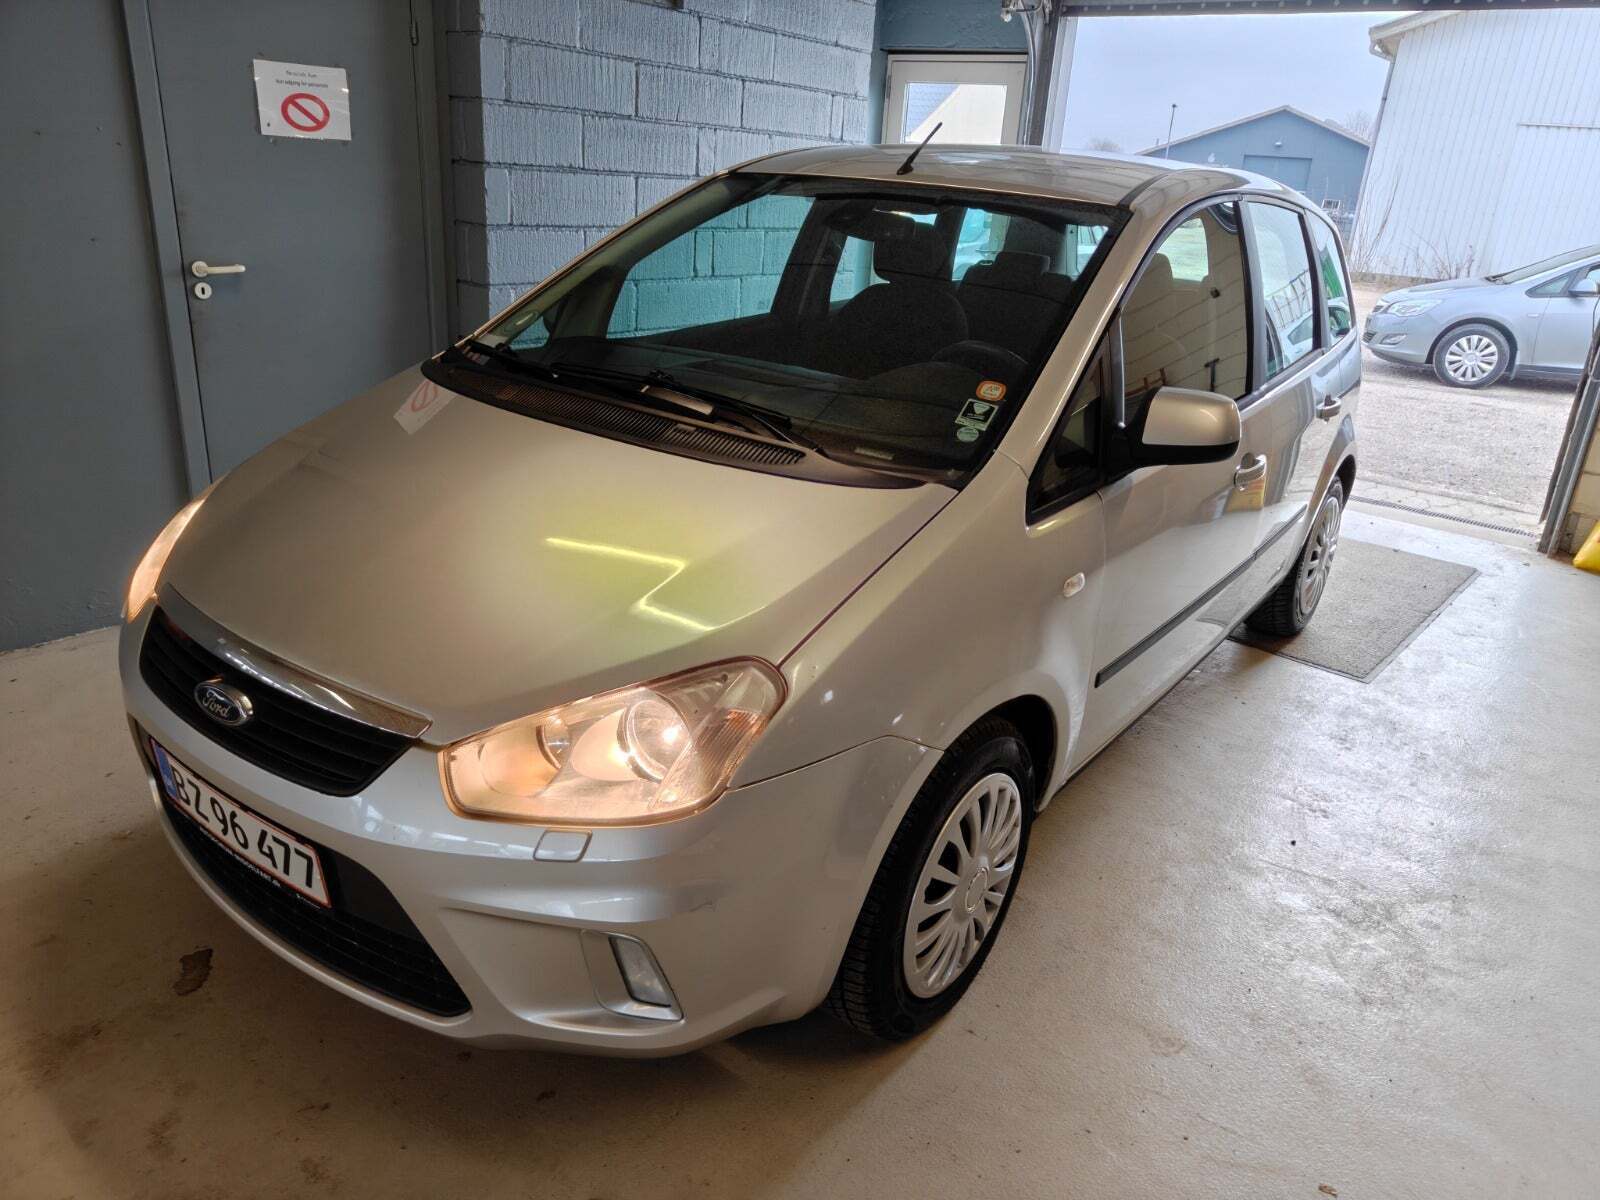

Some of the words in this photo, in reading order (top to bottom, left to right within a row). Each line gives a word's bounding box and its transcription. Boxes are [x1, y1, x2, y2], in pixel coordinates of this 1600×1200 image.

[202, 689, 231, 718] Ford
[172, 764, 210, 823] BZ
[210, 797, 249, 850] 96
[257, 829, 313, 889] 477
